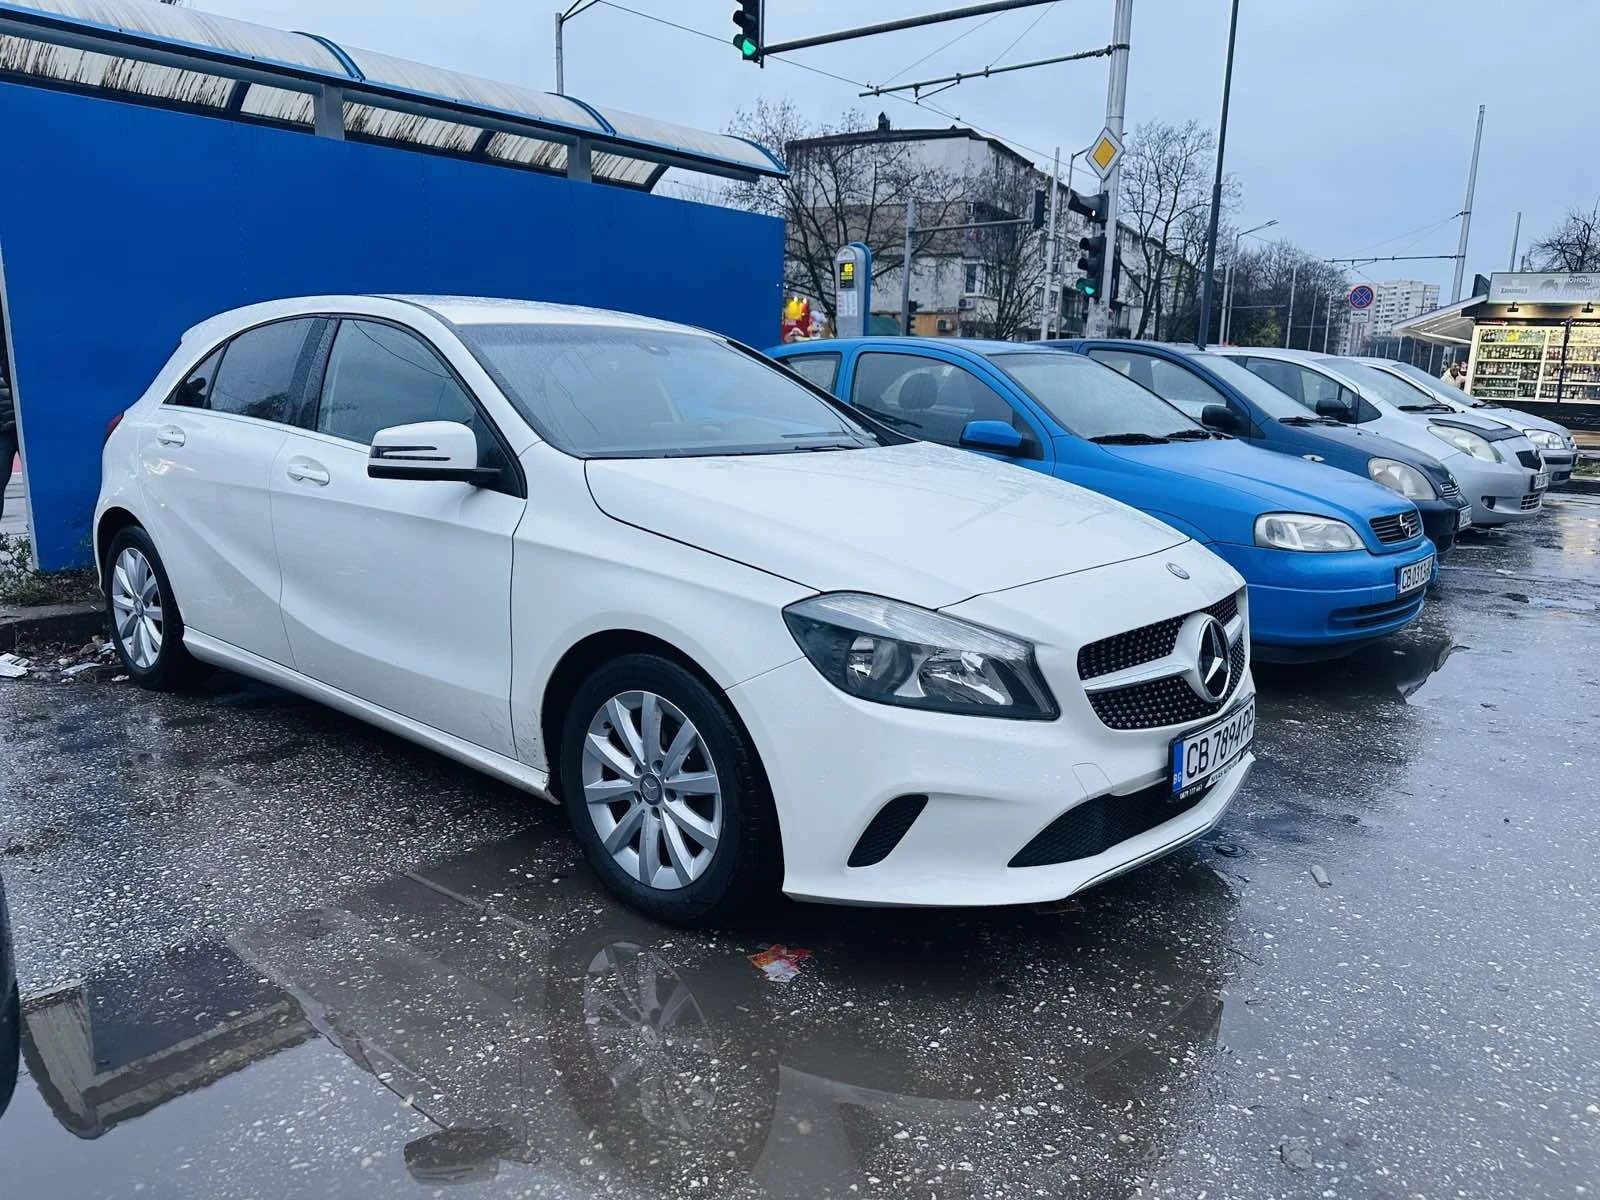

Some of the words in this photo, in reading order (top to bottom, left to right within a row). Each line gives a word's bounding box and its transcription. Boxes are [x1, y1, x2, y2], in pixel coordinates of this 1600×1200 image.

[1186, 738, 1209, 779] CB
[1212, 714, 1242, 767] 7894
[1173, 771, 1182, 785] BG
